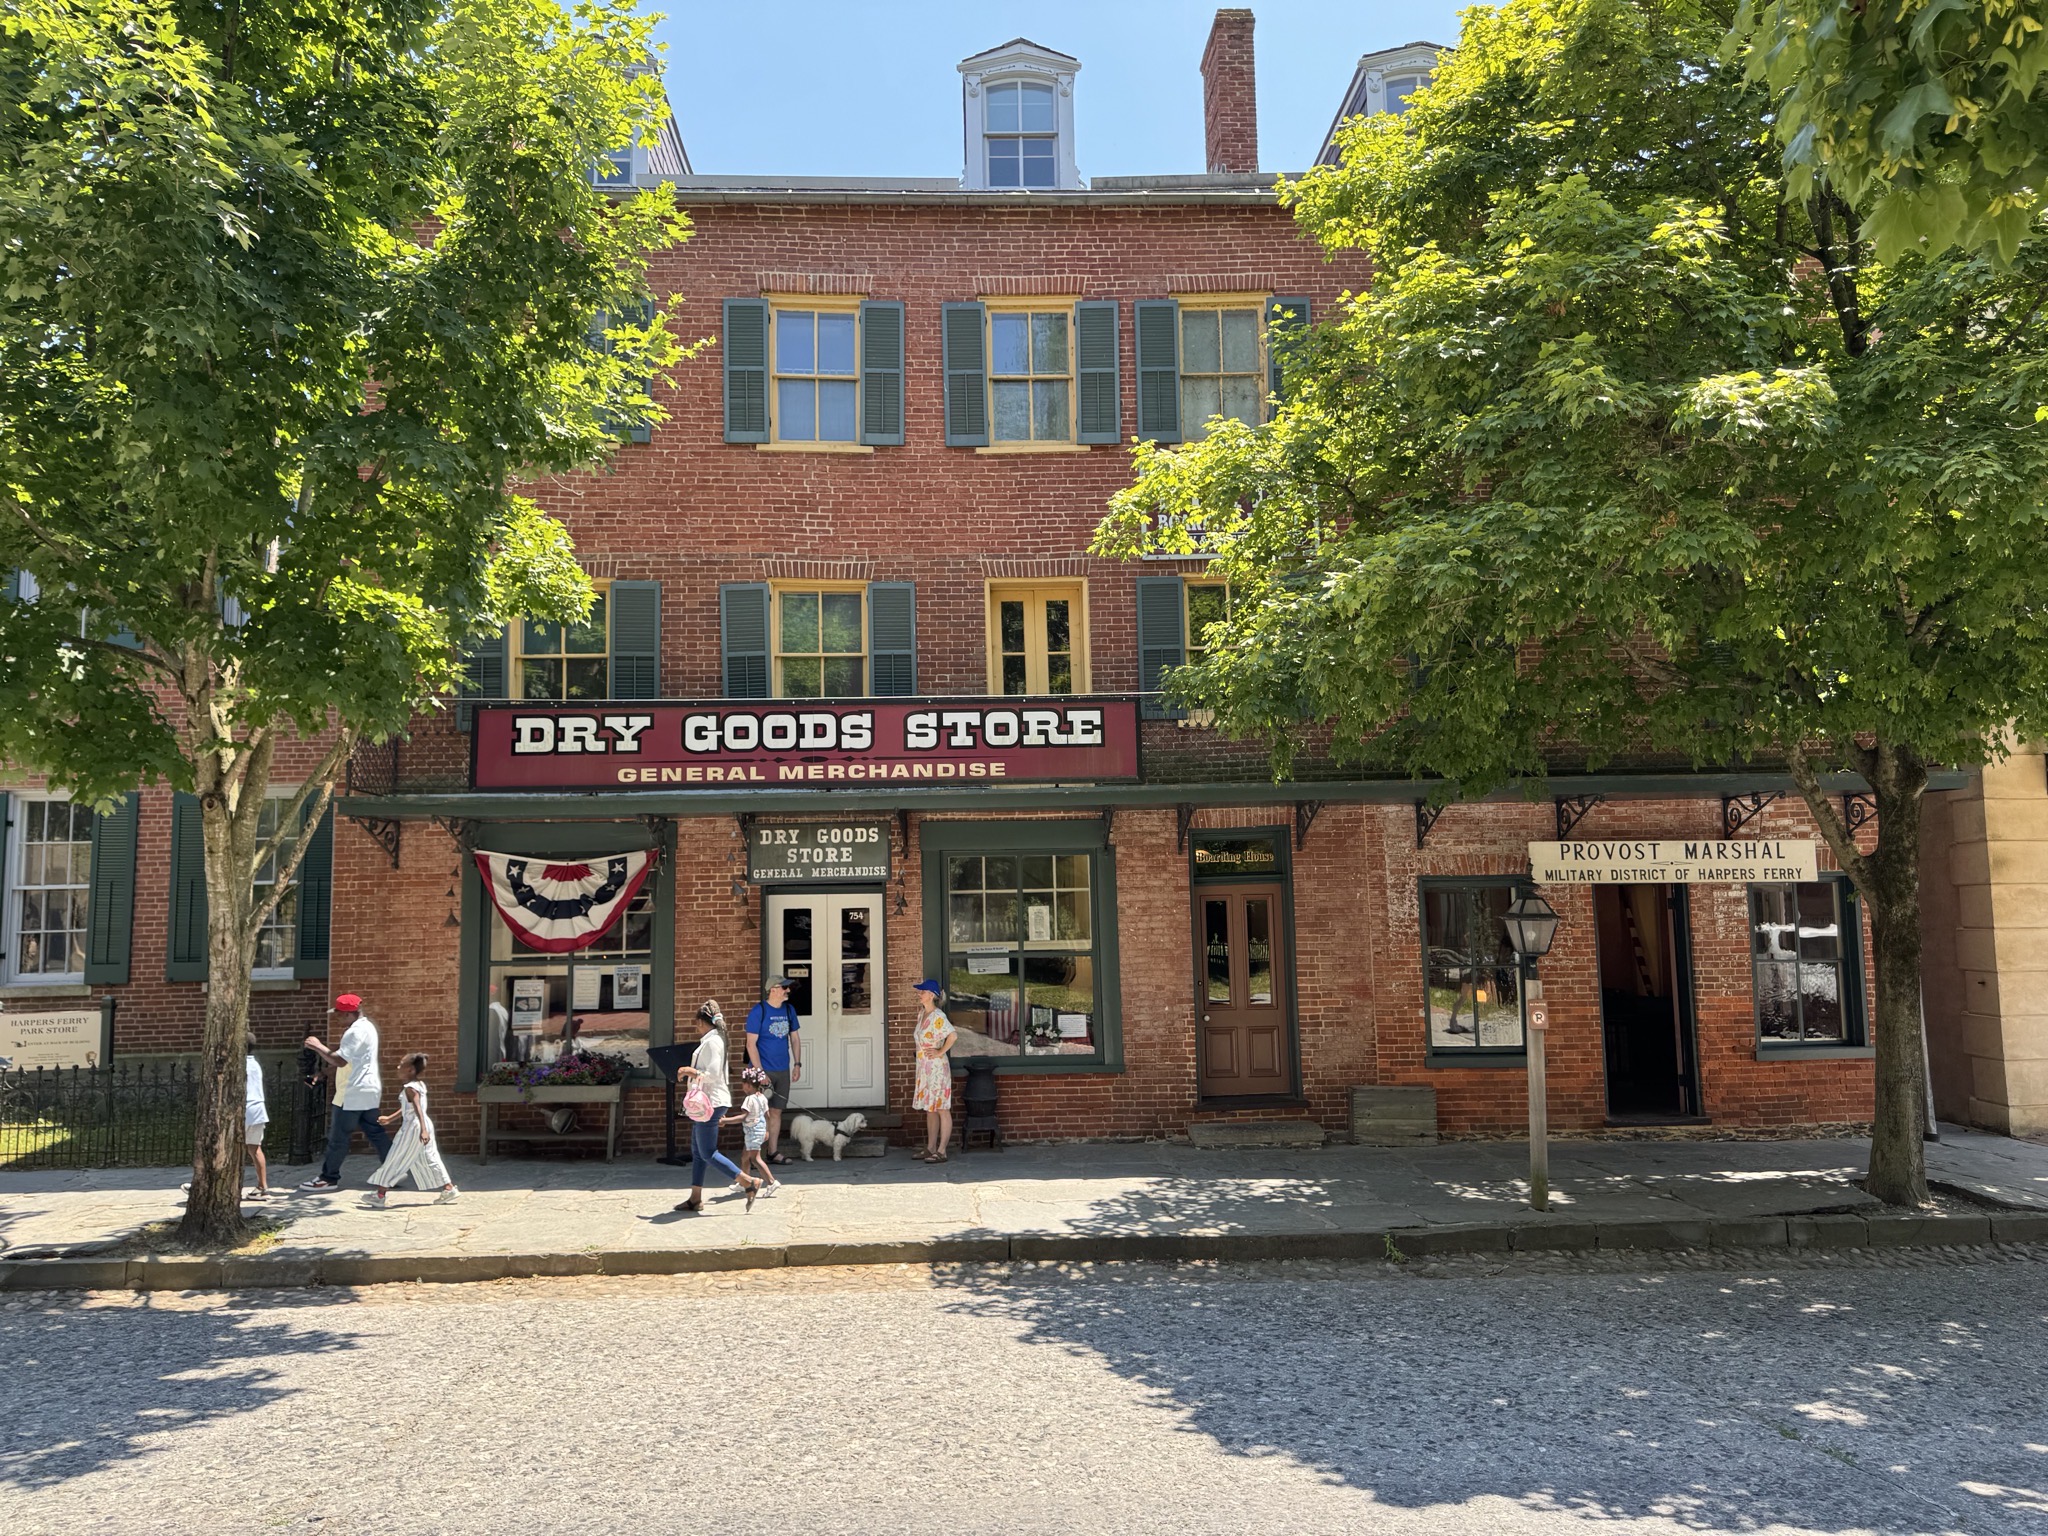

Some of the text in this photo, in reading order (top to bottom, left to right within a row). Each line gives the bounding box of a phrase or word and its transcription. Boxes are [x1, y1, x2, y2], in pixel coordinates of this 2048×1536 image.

[514, 710, 1103, 753] DRY GOODS STORE
[617, 762, 1007, 783] GENERAL MERCHANDISE
[759, 827, 879, 845] DRY GOODS
[787, 847, 853, 863] STORE
[1195, 849, 1275, 864] Boarding House
[1559, 841, 1787, 861] PROVOST MARSHAL
[753, 866, 887, 879] GENERAL MERCHANDISE
[1544, 867, 1803, 882] MILITARY DISTRICT OF HARPERS FERRY
[848, 911, 864, 920] 754
[10, 1017, 89, 1027] HARPERS FERRY
[20, 1026, 78, 1035] PARK STORE
